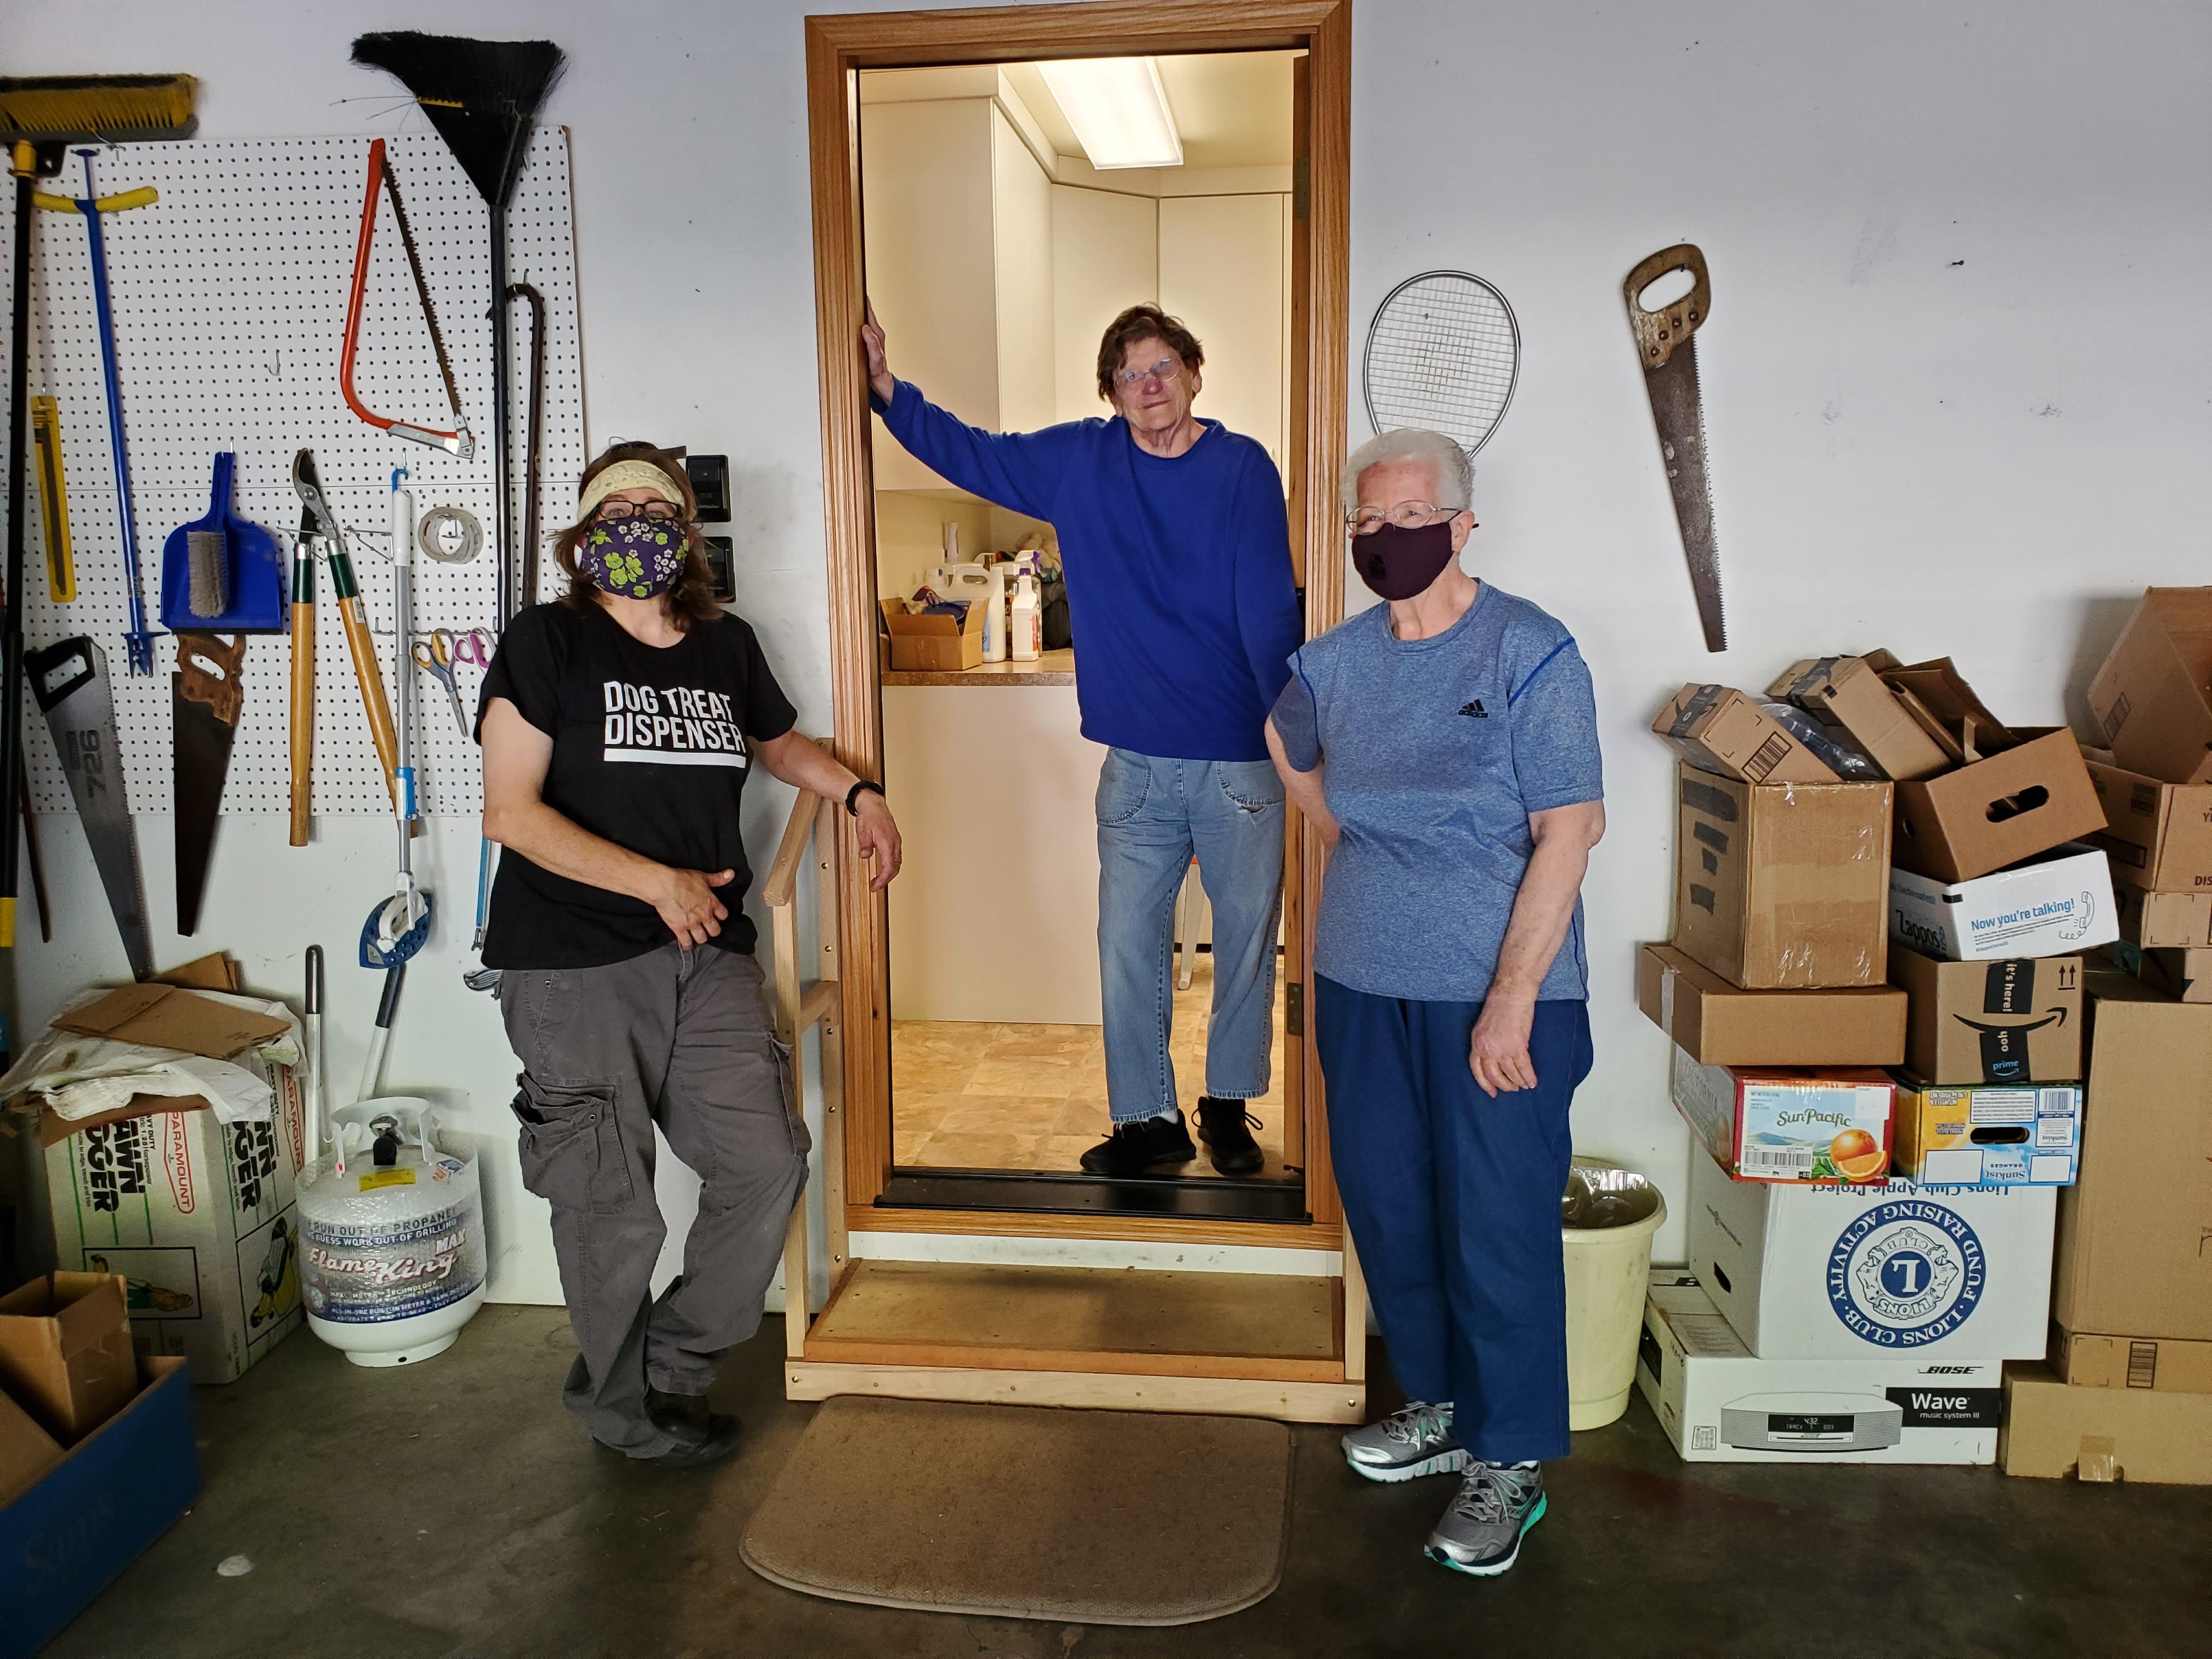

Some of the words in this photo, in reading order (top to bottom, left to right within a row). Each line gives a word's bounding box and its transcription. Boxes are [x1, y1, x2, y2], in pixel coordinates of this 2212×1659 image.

[604, 681, 659, 714] DOG
[661, 687, 733, 722] TREAT
[605, 713, 746, 753] DISPENSER
[80, 730, 106, 798] 726
[1971, 918, 1995, 931] Now
[1997, 907, 2030, 928] you're
[2033, 898, 2075, 918] talking!
[1895, 909, 1940, 950] Zappos
[2006, 964, 2017, 981] it's
[2003, 984, 2015, 1012] here!
[1993, 1060, 2019, 1071] prime
[1776, 1111, 1804, 1126] Sun
[1804, 1108, 1851, 1127] Pacific
[85, 1125, 120, 1212] DGER
[112, 1120, 146, 1193] AWN
[143, 1146, 152, 1185] Horsepower
[172, 1112, 190, 1207] PARAMOUNT
[1872, 1182, 1917, 1195] Apple
[1984, 1170, 2026, 1181] Sunkist
[1810, 1184, 1865, 1195] Project
[1926, 1185, 1961, 1195] Club
[1968, 1185, 2008, 1195] Lions
[339, 1226, 365, 1235] OUT
[374, 1235, 396, 1245] OUT
[399, 1232, 413, 1242] OF
[416, 1218, 457, 1238] GRILLING
[1883, 1203, 1968, 1240] RAISING
[1831, 1211, 1877, 1302] ACTIVITY
[1888, 1237, 1929, 1249] CLUB
[1892, 1260, 1920, 1293] L
[1962, 1240, 1982, 1302] FUND
[386, 1279, 437, 1297] TECHNOLOGY
[1878, 1298, 1931, 1316] LIONS
[1845, 1310, 1897, 1344] CLUB
[1902, 1308, 1964, 1345] LIONS
[1918, 1365, 1984, 1375] BOSE
[1911, 1393, 1968, 1410] Wave
[1943, 1412, 1972, 1420] system
